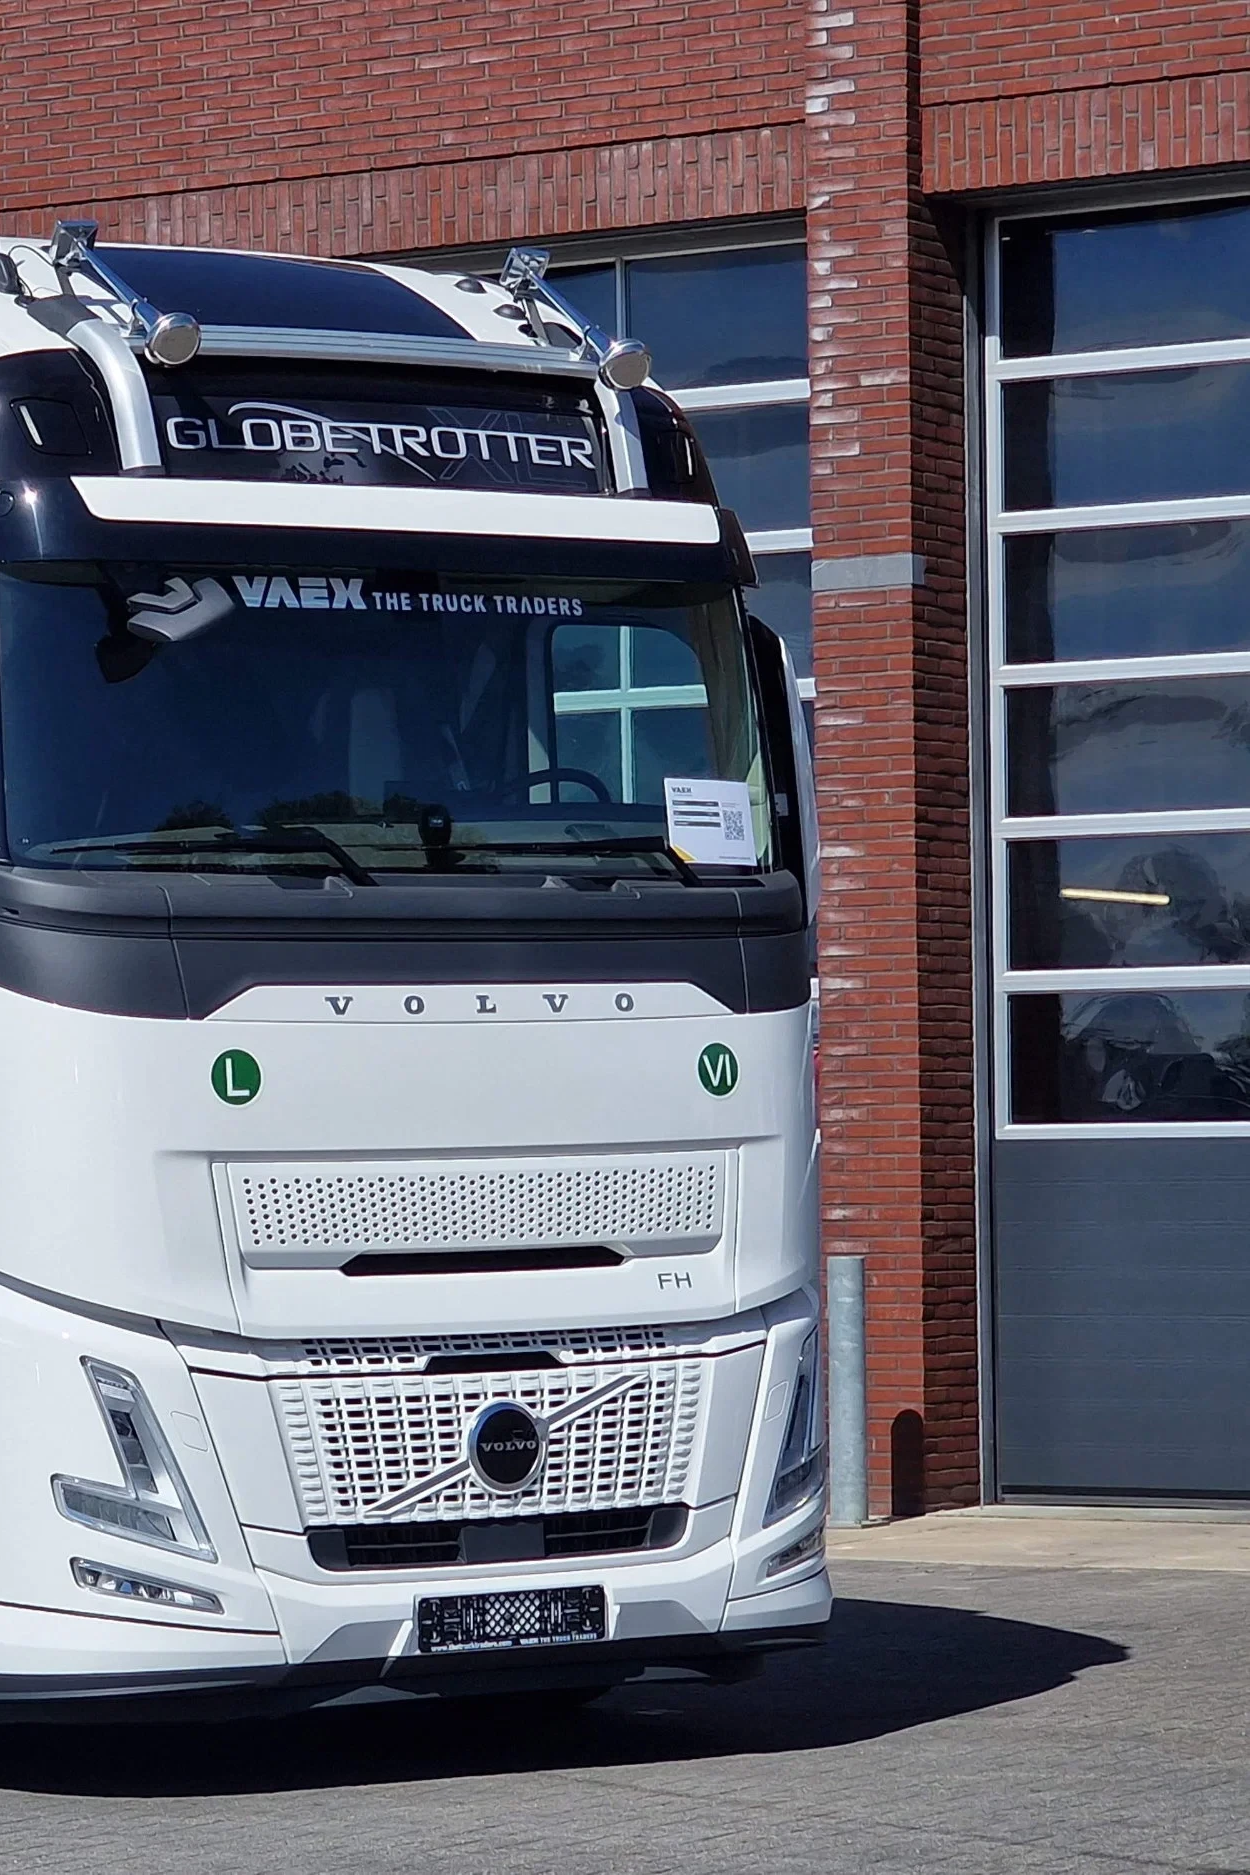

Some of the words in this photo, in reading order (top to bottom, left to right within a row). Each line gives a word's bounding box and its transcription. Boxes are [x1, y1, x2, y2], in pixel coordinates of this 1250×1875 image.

[166, 415, 596, 470] GLOBETROTTER
[231, 575, 368, 610] VAEX
[371, 591, 413, 611] THE
[418, 592, 488, 614] TRUCK
[492, 594, 583, 617] TRADERS
[324, 992, 635, 1016] VOLVO
[225, 1057, 250, 1097] L
[702, 1053, 732, 1087] VI
[657, 1271, 692, 1290] FH
[480, 1440, 537, 1452] VOLVO
